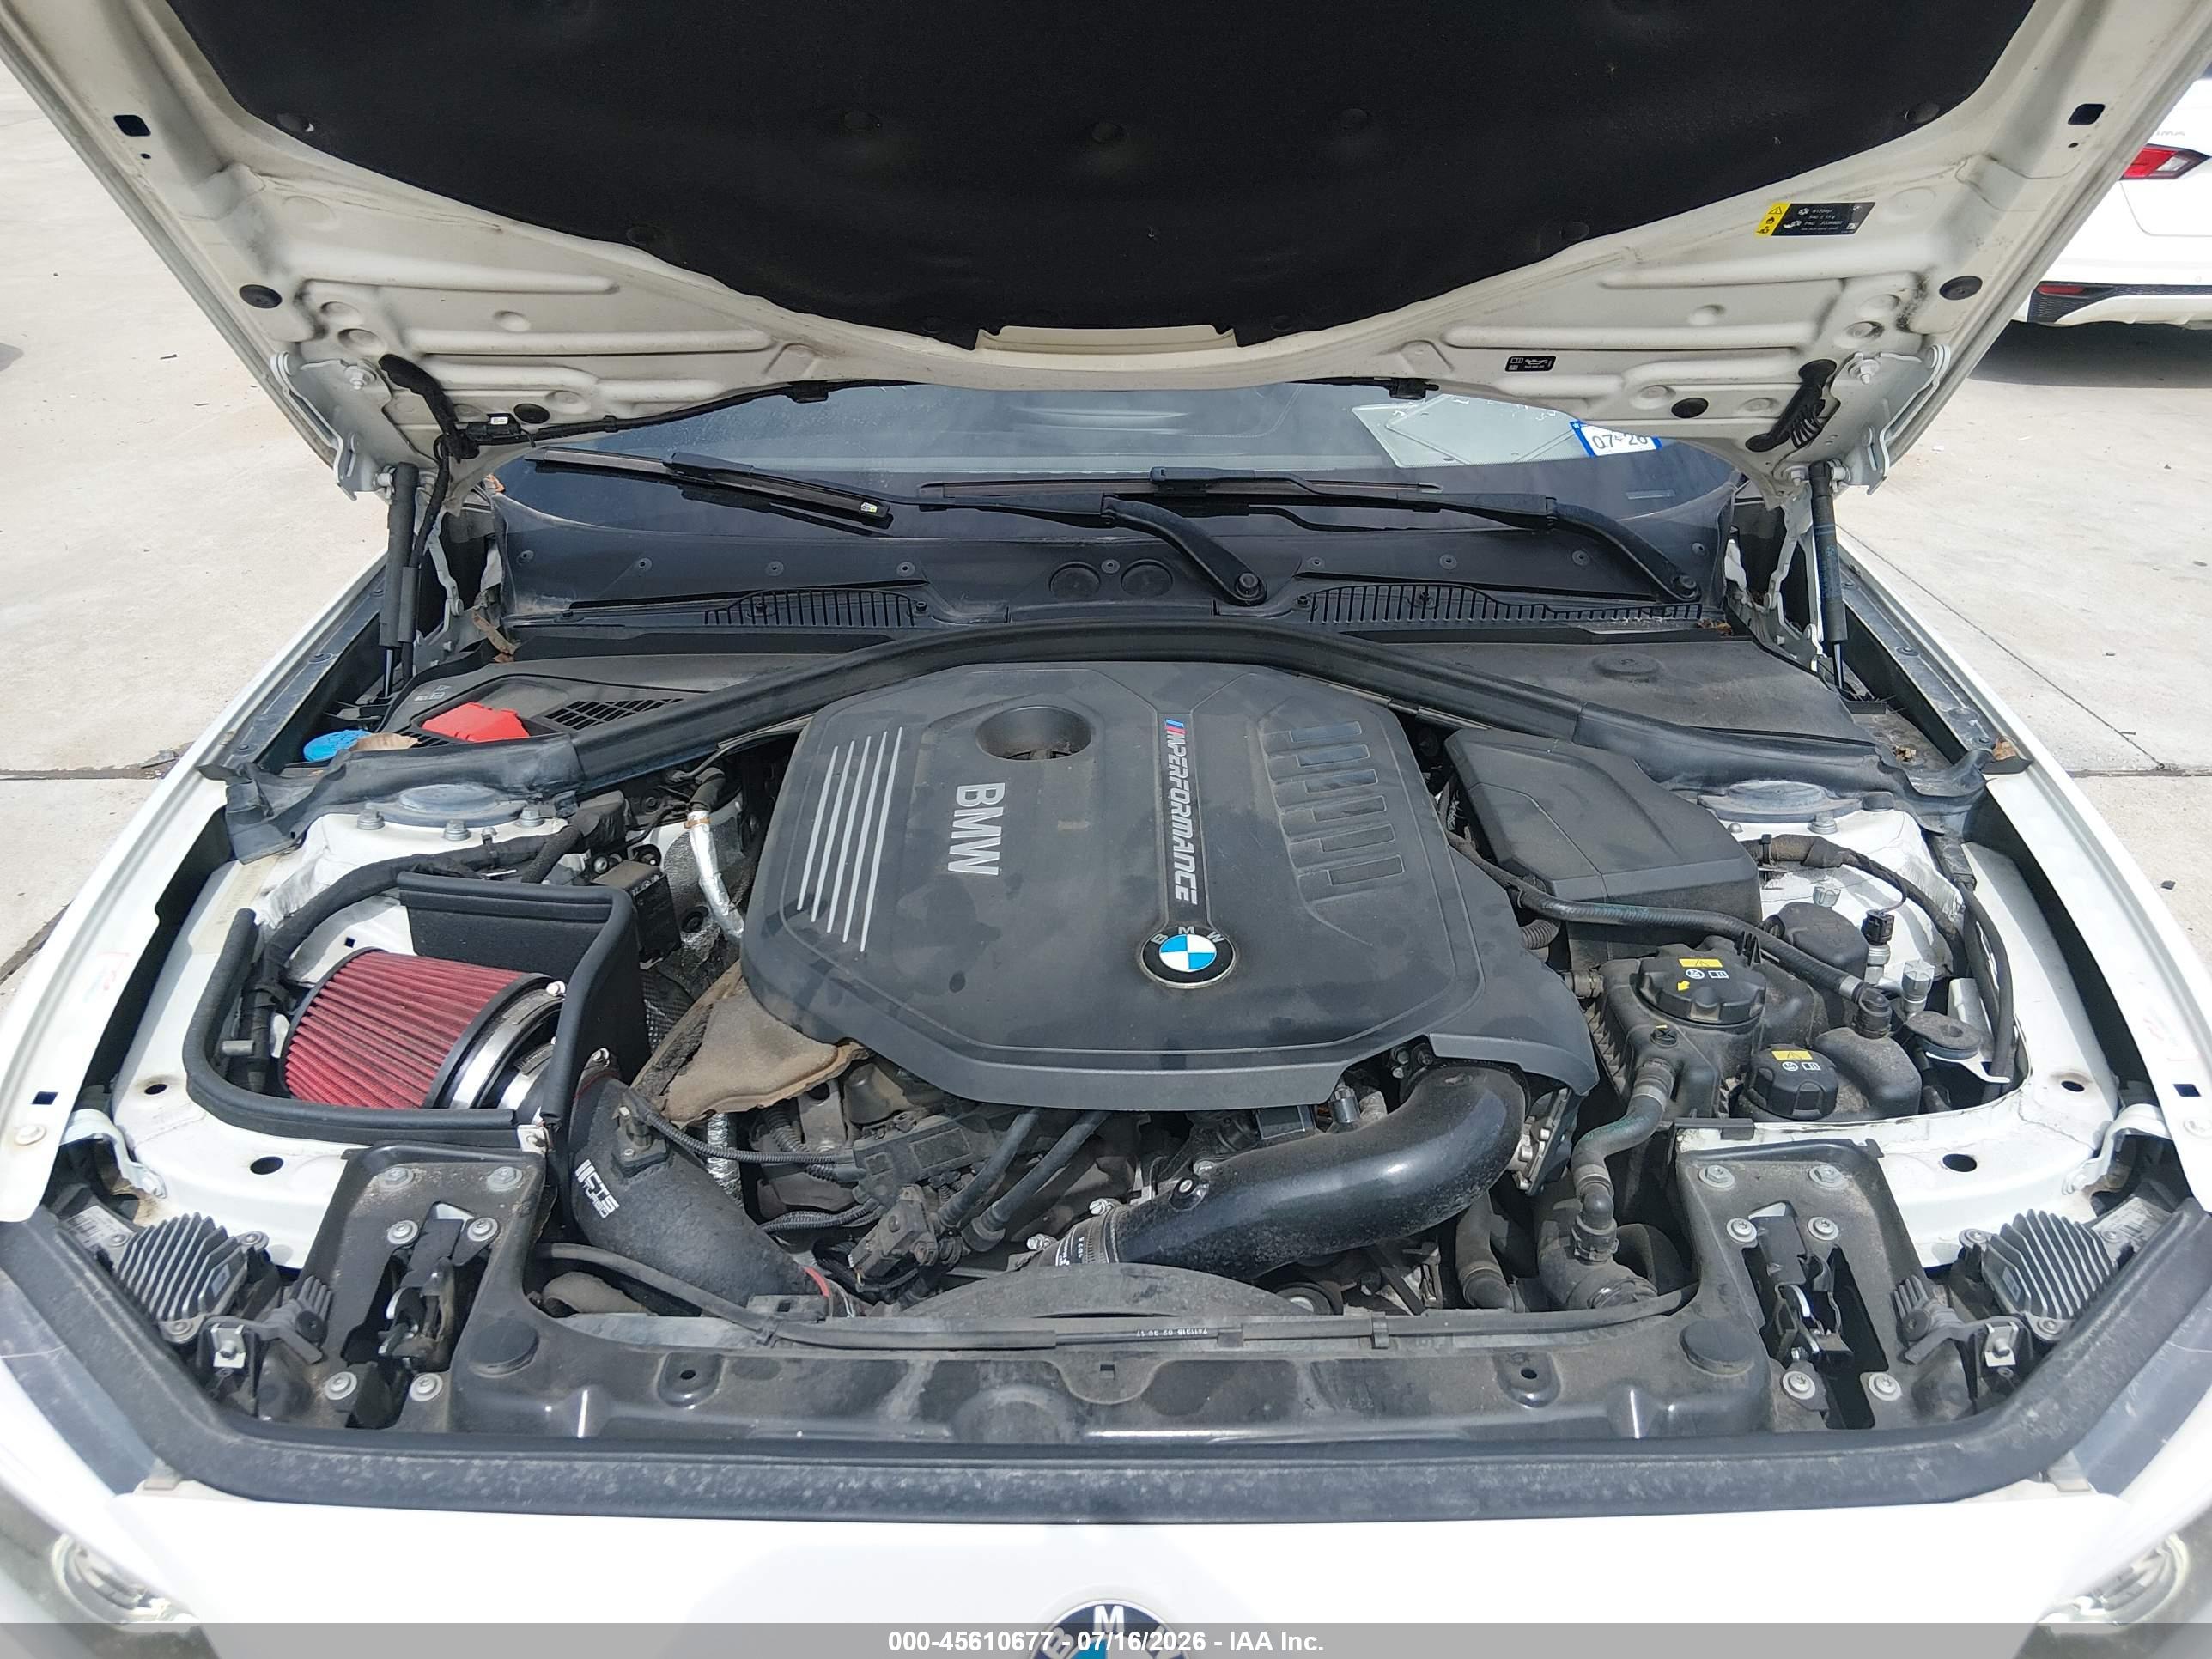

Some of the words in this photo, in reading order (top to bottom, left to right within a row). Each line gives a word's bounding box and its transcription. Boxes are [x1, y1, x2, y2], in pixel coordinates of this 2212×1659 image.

[1592, 434, 1613, 449] 07
[947, 782, 1006, 876] BMW
[1150, 926, 1225, 945] BMW
